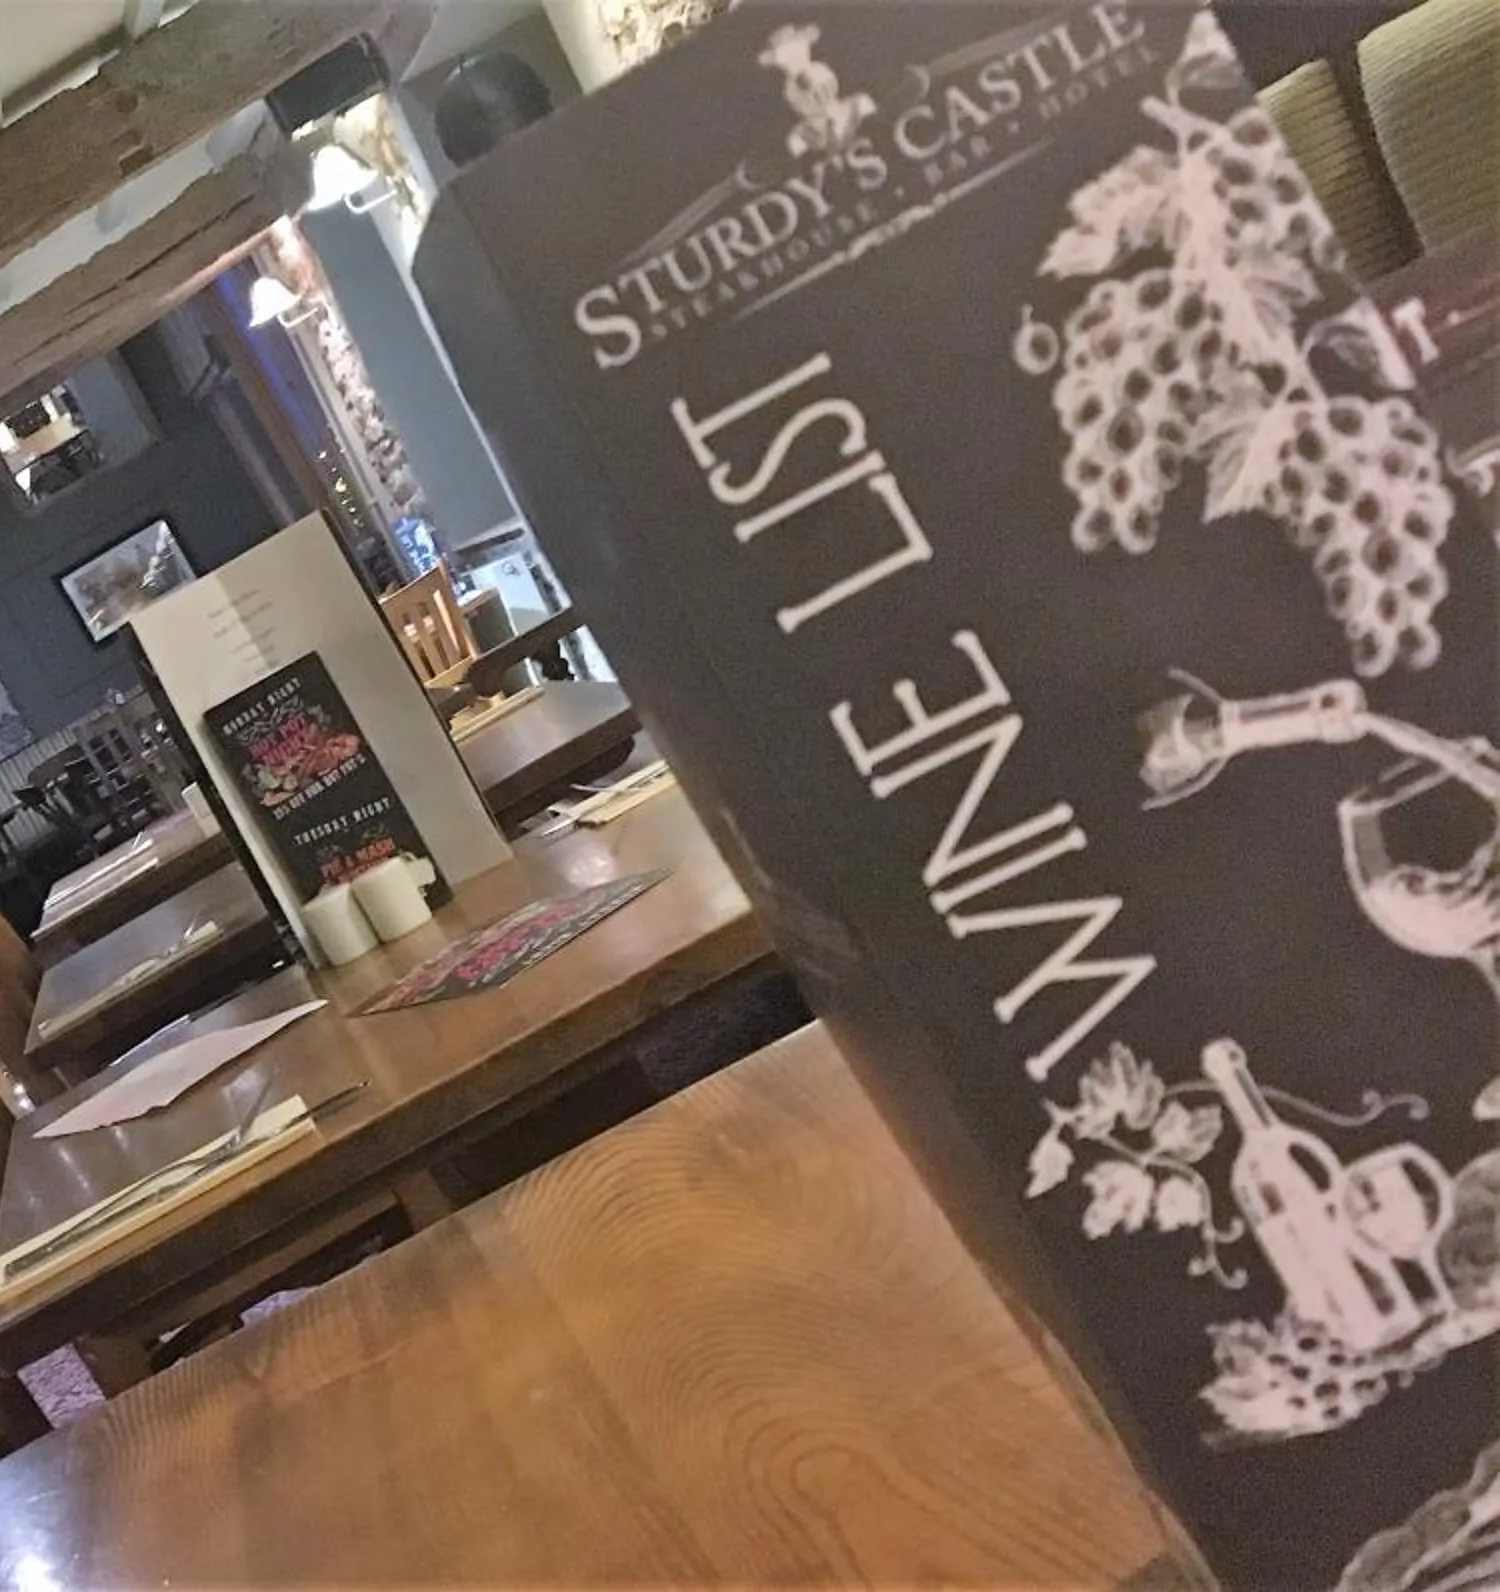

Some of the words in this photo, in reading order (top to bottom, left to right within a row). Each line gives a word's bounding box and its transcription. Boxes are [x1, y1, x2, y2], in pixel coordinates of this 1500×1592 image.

[574, 137, 889, 369] STURDY'S
[894, 0, 1146, 160] CASTLE
[651, 201, 876, 344] STEAKHOUSE
[924, 135, 991, 187] BAR
[1038, 45, 1160, 120] HOTEL
[671, 351, 933, 634] LIST
[294, 814, 349, 845] TUESDAY
[351, 797, 390, 822] NIGHT
[830, 629, 1158, 1082] WINE
